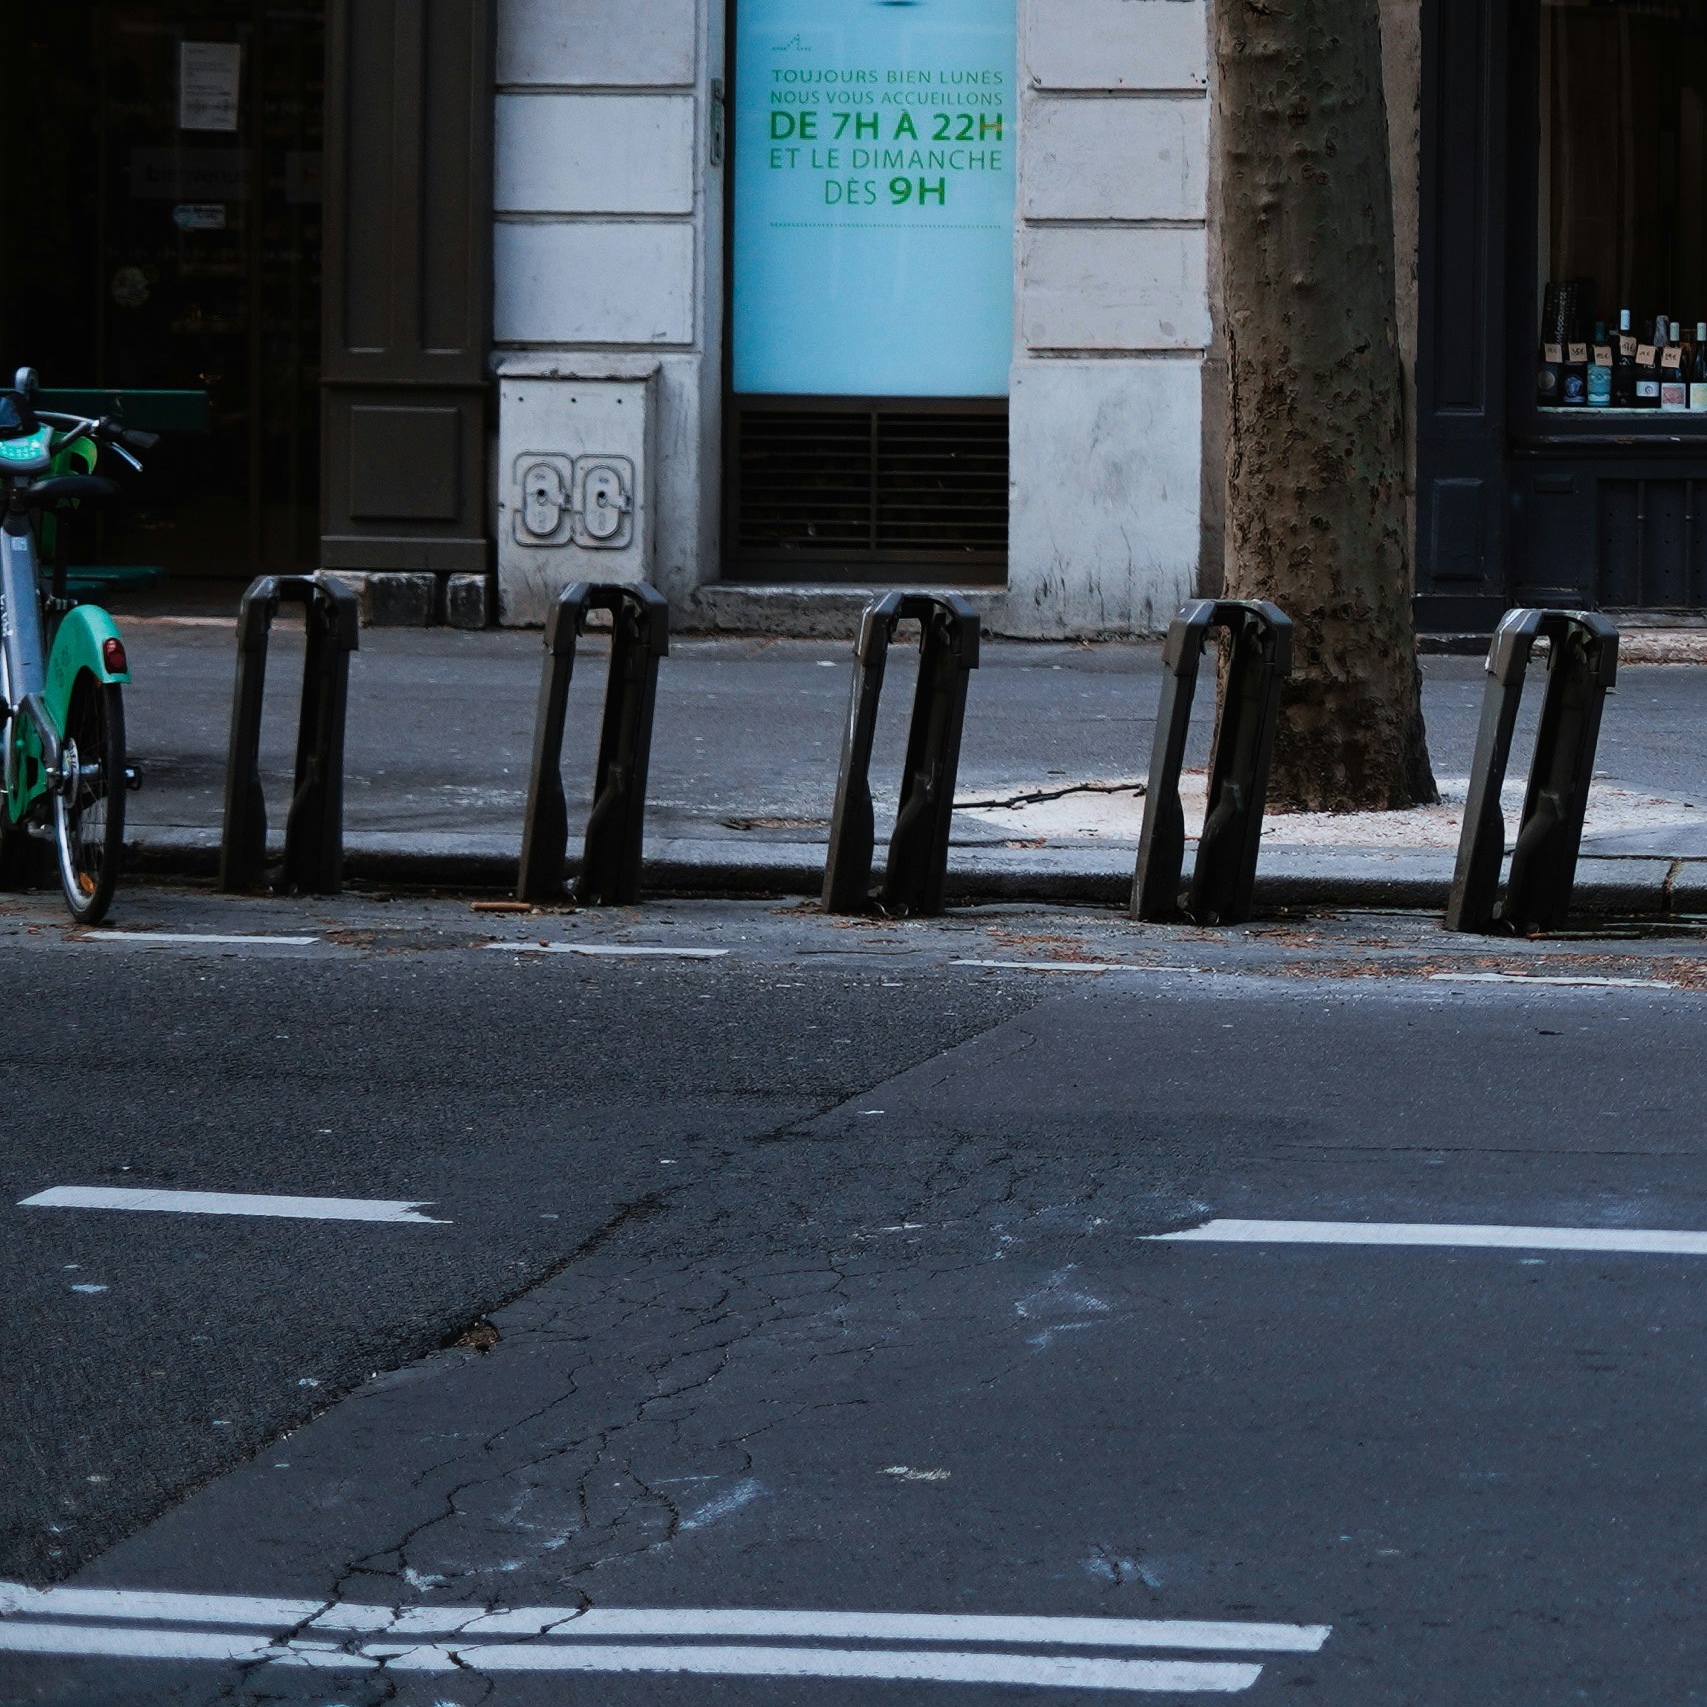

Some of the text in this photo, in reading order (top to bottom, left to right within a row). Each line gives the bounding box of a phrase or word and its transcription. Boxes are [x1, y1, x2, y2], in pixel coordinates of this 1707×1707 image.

[771, 68, 1003, 85] TOUJOURS BIEN LUNÉS
[770, 90, 1003, 105] NOUS VOUS ACCUEILLONS
[770, 109, 1003, 141] DE 7H À 22H
[770, 148, 1003, 170] ET LE DIMANCHE
[825, 176, 945, 205] DÈS 9H
